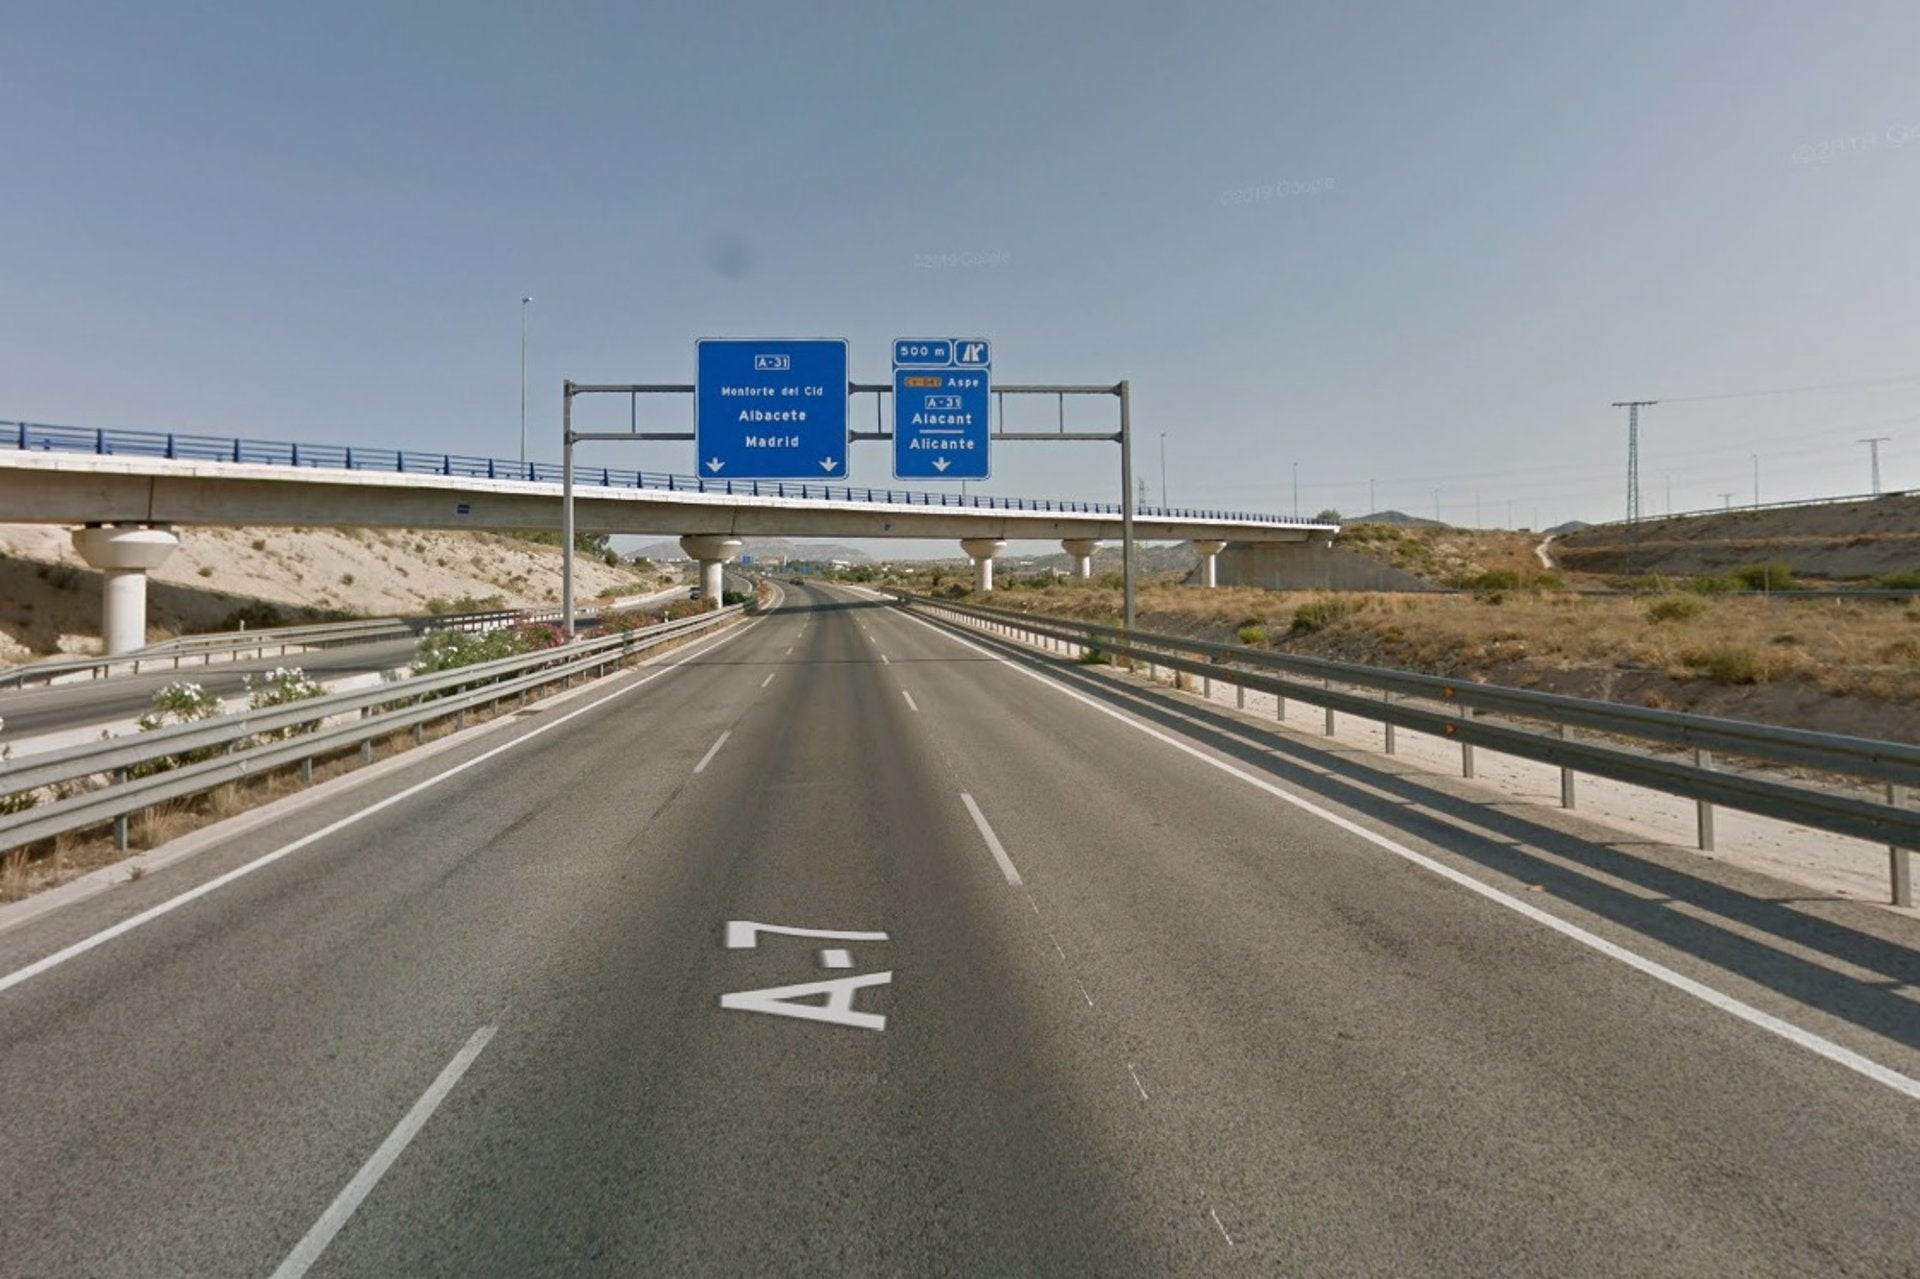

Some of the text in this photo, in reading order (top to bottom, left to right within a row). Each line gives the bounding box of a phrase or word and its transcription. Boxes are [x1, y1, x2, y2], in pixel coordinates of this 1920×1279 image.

[900, 346, 945, 356] 500 m
[758, 357, 787, 368] A-31
[948, 378, 979, 389] Aspe
[721, 387, 824, 396] Monforte del Cid
[928, 397, 961, 408] A-31
[738, 410, 807, 421] Albacete
[912, 413, 972, 424] Alacant
[745, 436, 800, 447] Madrid
[909, 438, 975, 449] Alicante
